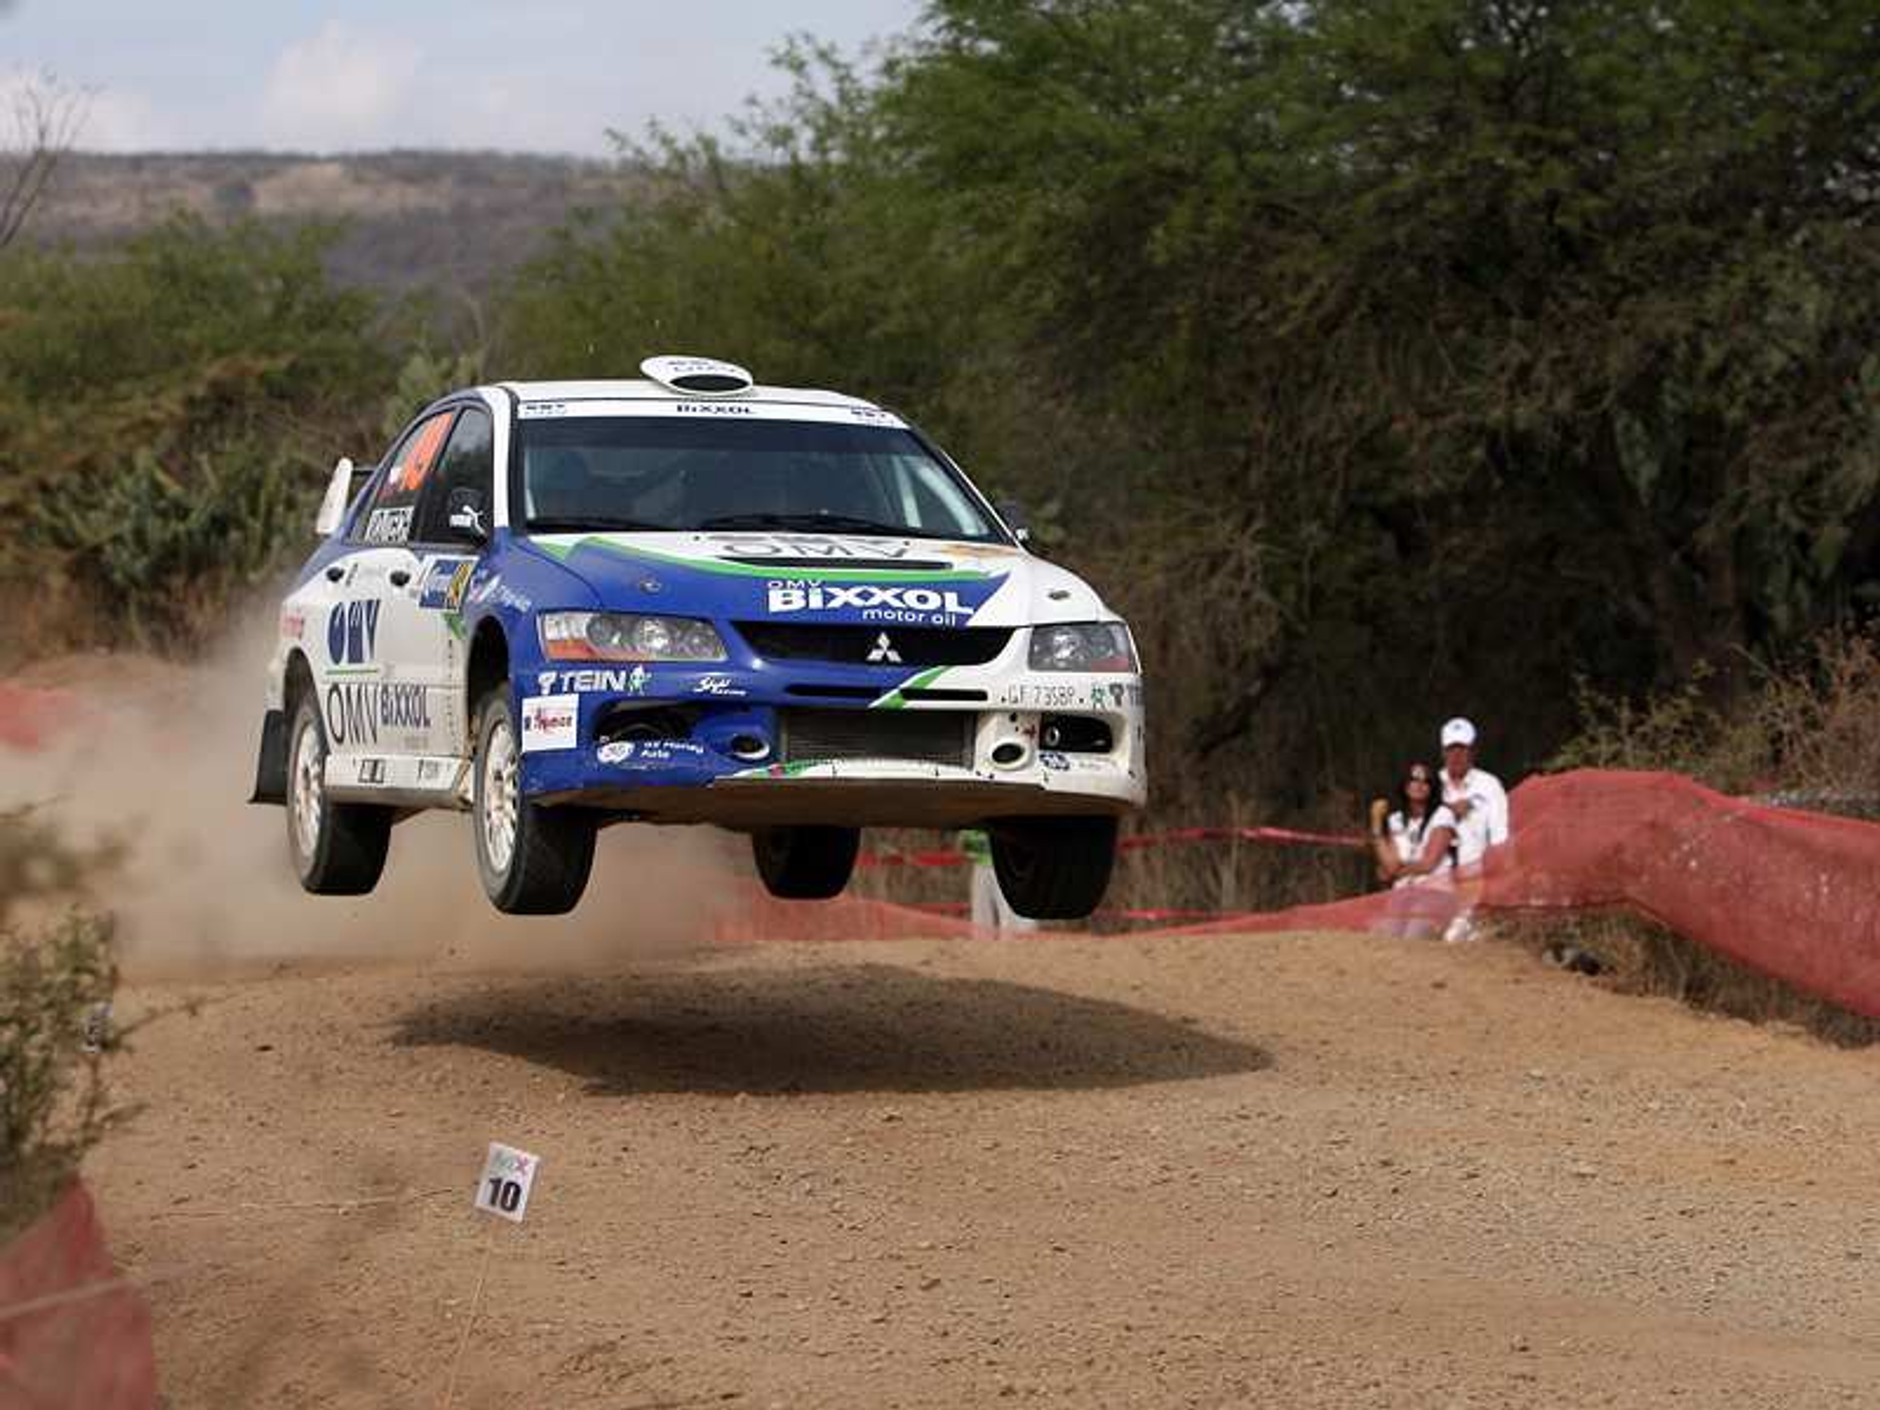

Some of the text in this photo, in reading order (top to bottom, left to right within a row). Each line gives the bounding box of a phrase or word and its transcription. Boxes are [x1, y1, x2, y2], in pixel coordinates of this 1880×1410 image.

[862, 607, 956, 627] motor oil
[559, 669, 627, 693] TEIN
[326, 681, 378, 744] OMV
[488, 1177, 522, 1212] 10
